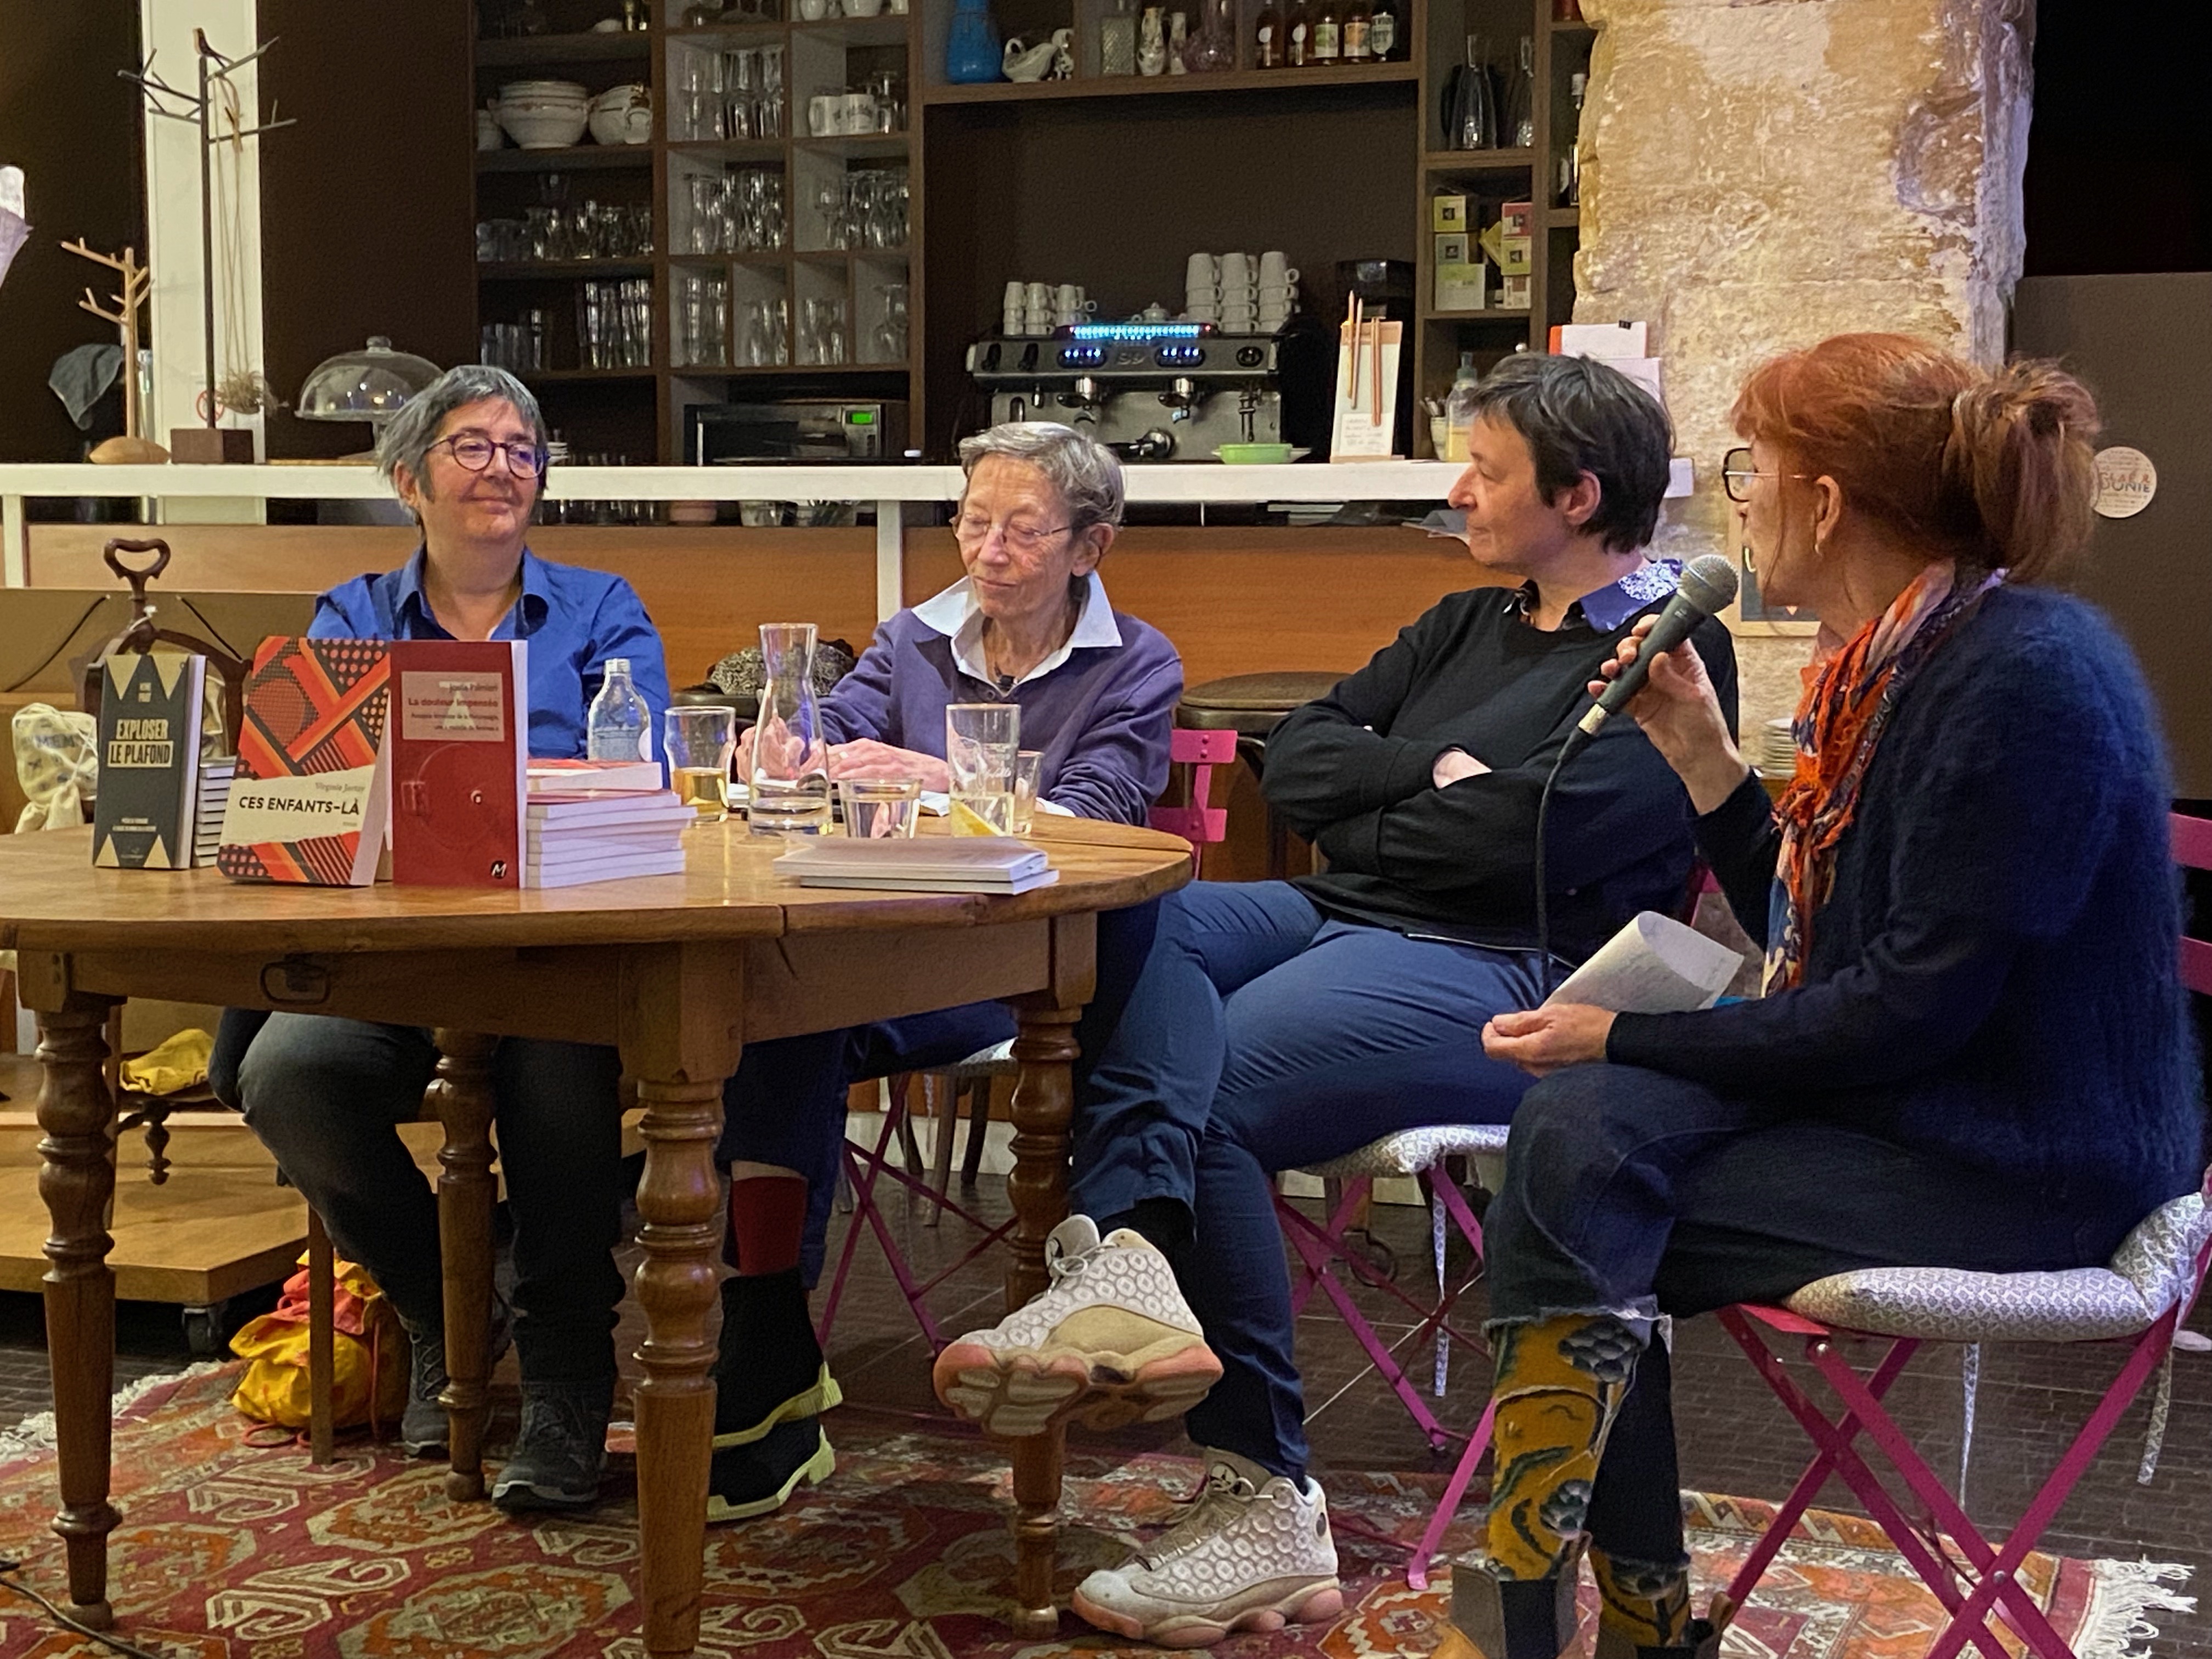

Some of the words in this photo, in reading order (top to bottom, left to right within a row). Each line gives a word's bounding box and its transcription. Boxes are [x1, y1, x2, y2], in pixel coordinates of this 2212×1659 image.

[116, 719, 168, 740] EXPLOSER
[110, 744, 122, 764] LE
[125, 744, 171, 764] PLAFOND
[239, 796, 264, 809] CES
[267, 797, 360, 815] ENFANTS-LÀ
